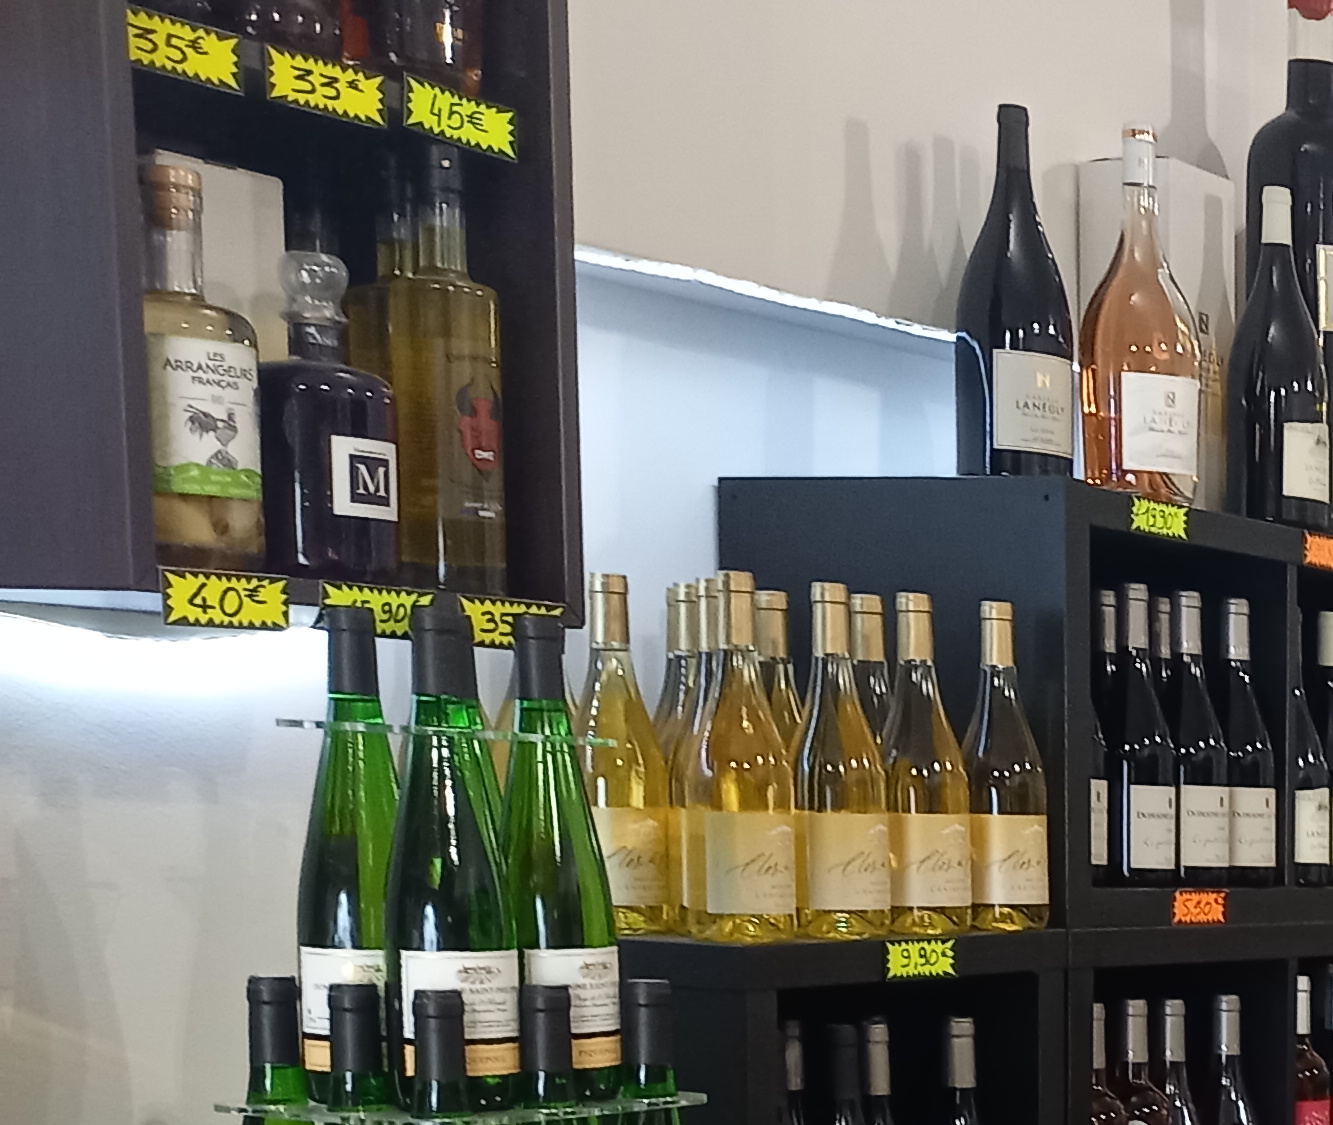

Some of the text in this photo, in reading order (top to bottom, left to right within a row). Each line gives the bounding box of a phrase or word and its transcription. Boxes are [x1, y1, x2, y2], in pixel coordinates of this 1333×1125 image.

[162, 355, 255, 383] ARRANGEURS
[205, 350, 226, 363] LES
[190, 373, 240, 393] FRANÇAIS
[354, 461, 388, 498] M
[187, 583, 267, 618] 40€
